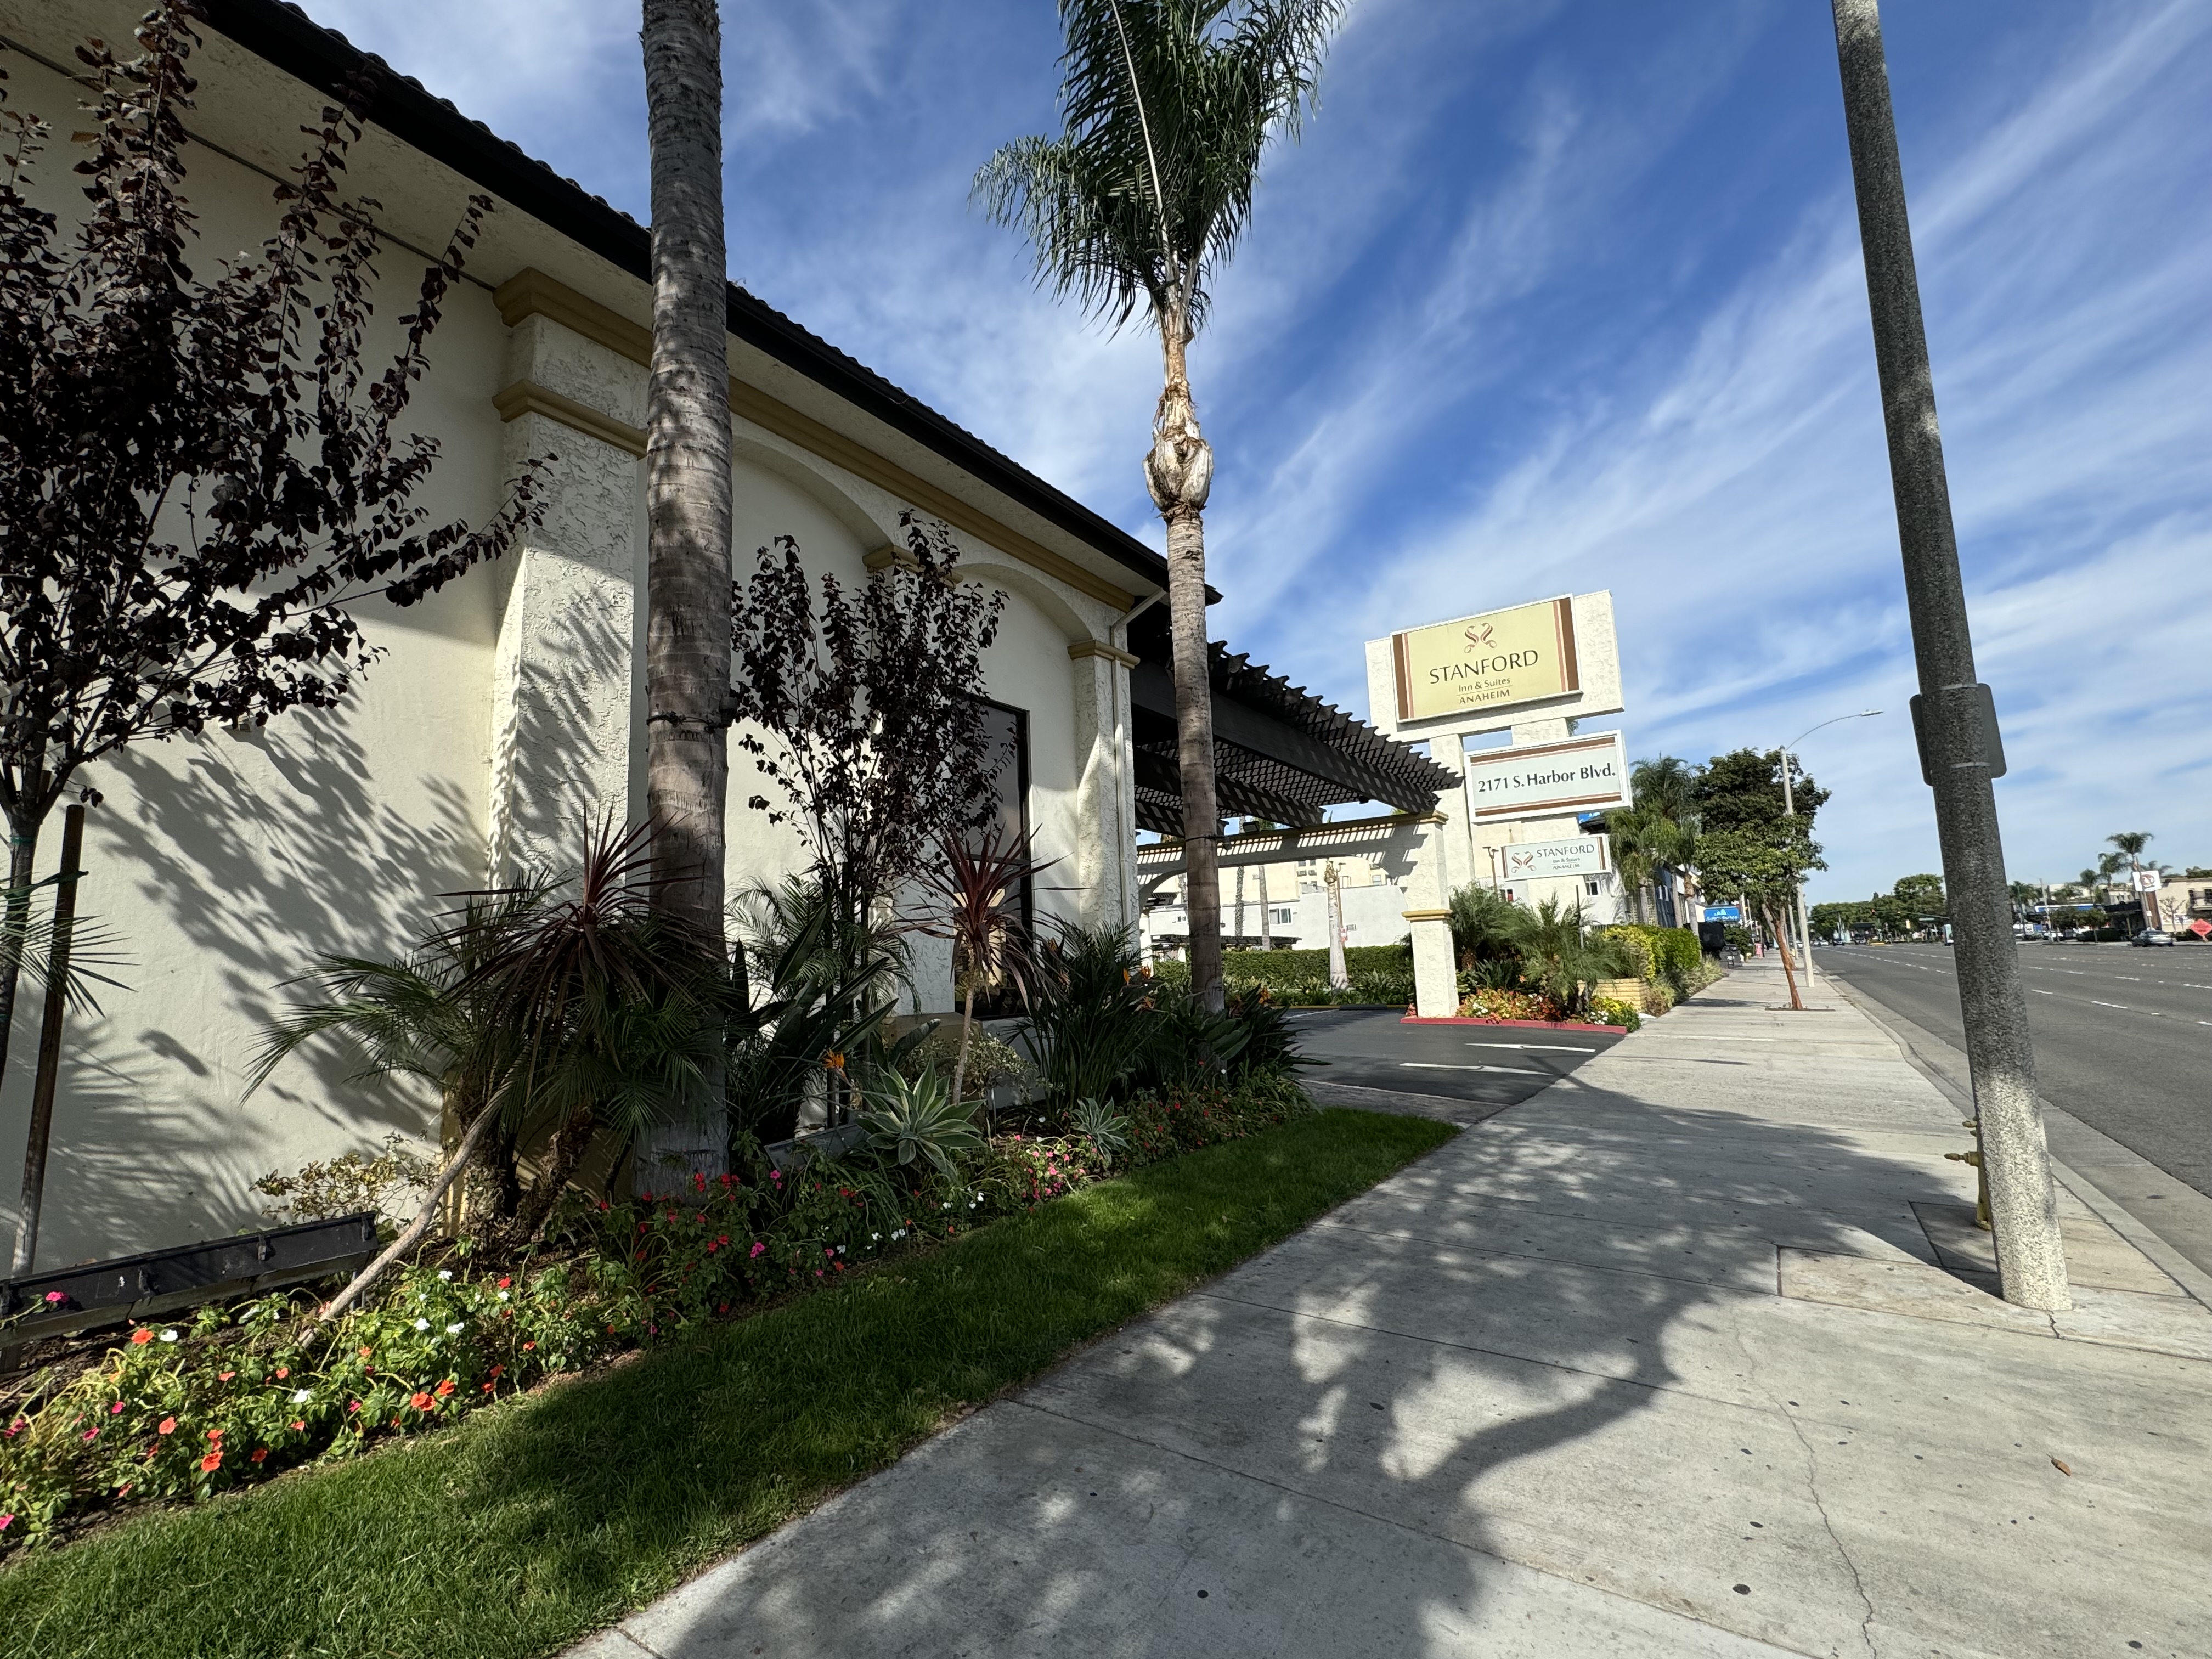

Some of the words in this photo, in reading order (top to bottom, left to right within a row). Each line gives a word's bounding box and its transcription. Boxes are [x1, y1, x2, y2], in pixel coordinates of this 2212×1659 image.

[1430, 650, 1538, 684] STANFORD
[1475, 681, 1482, 690] &
[1484, 678, 1511, 688] Suites
[1459, 689, 1510, 704] ANAHEIM
[1477, 777, 1508, 792] 2171
[1513, 775, 1525, 788] S.
[1527, 770, 1576, 786] Harbor
[1580, 763, 1616, 780] Blvd.
[1537, 844, 1594, 858] STANFORD
